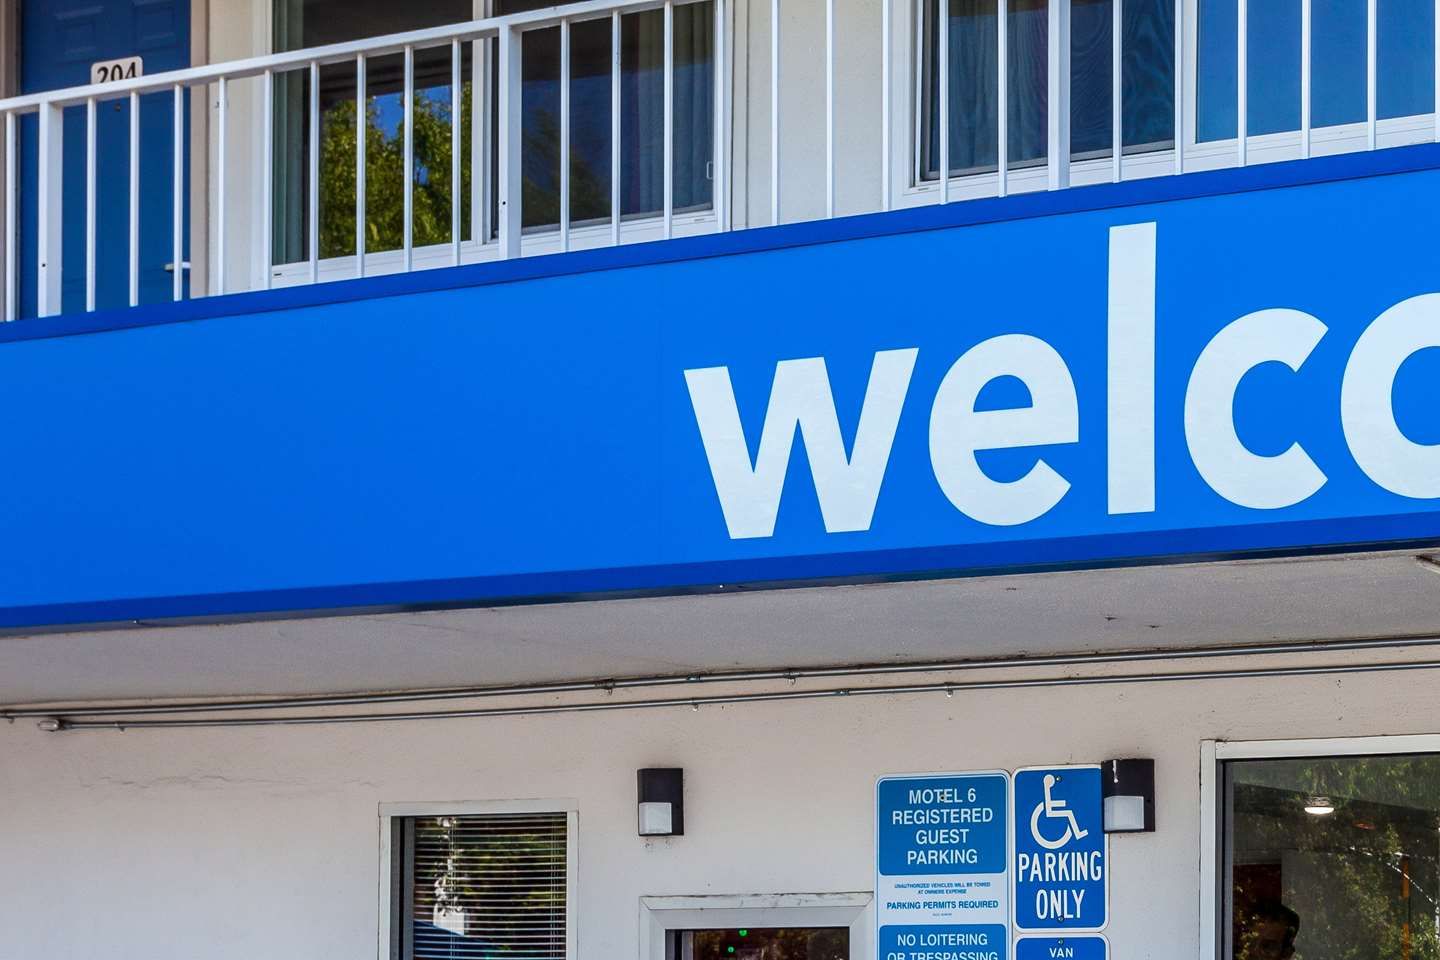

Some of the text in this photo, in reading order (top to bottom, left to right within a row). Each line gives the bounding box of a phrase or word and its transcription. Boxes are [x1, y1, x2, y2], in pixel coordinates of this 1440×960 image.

[97, 62, 136, 83] 204
[909, 788, 976, 804] MOTEL 6
[892, 808, 993, 825] REGISTERED
[915, 828, 969, 845] GUEST
[907, 849, 978, 865] PARKING
[1018, 851, 1102, 882] PARKING
[887, 900, 999, 910] PARKING PERMITS REQUIRED
[1036, 889, 1085, 919] ONLY
[897, 933, 988, 946] NO LOITERING
[1049, 948, 1073, 958] VAN
